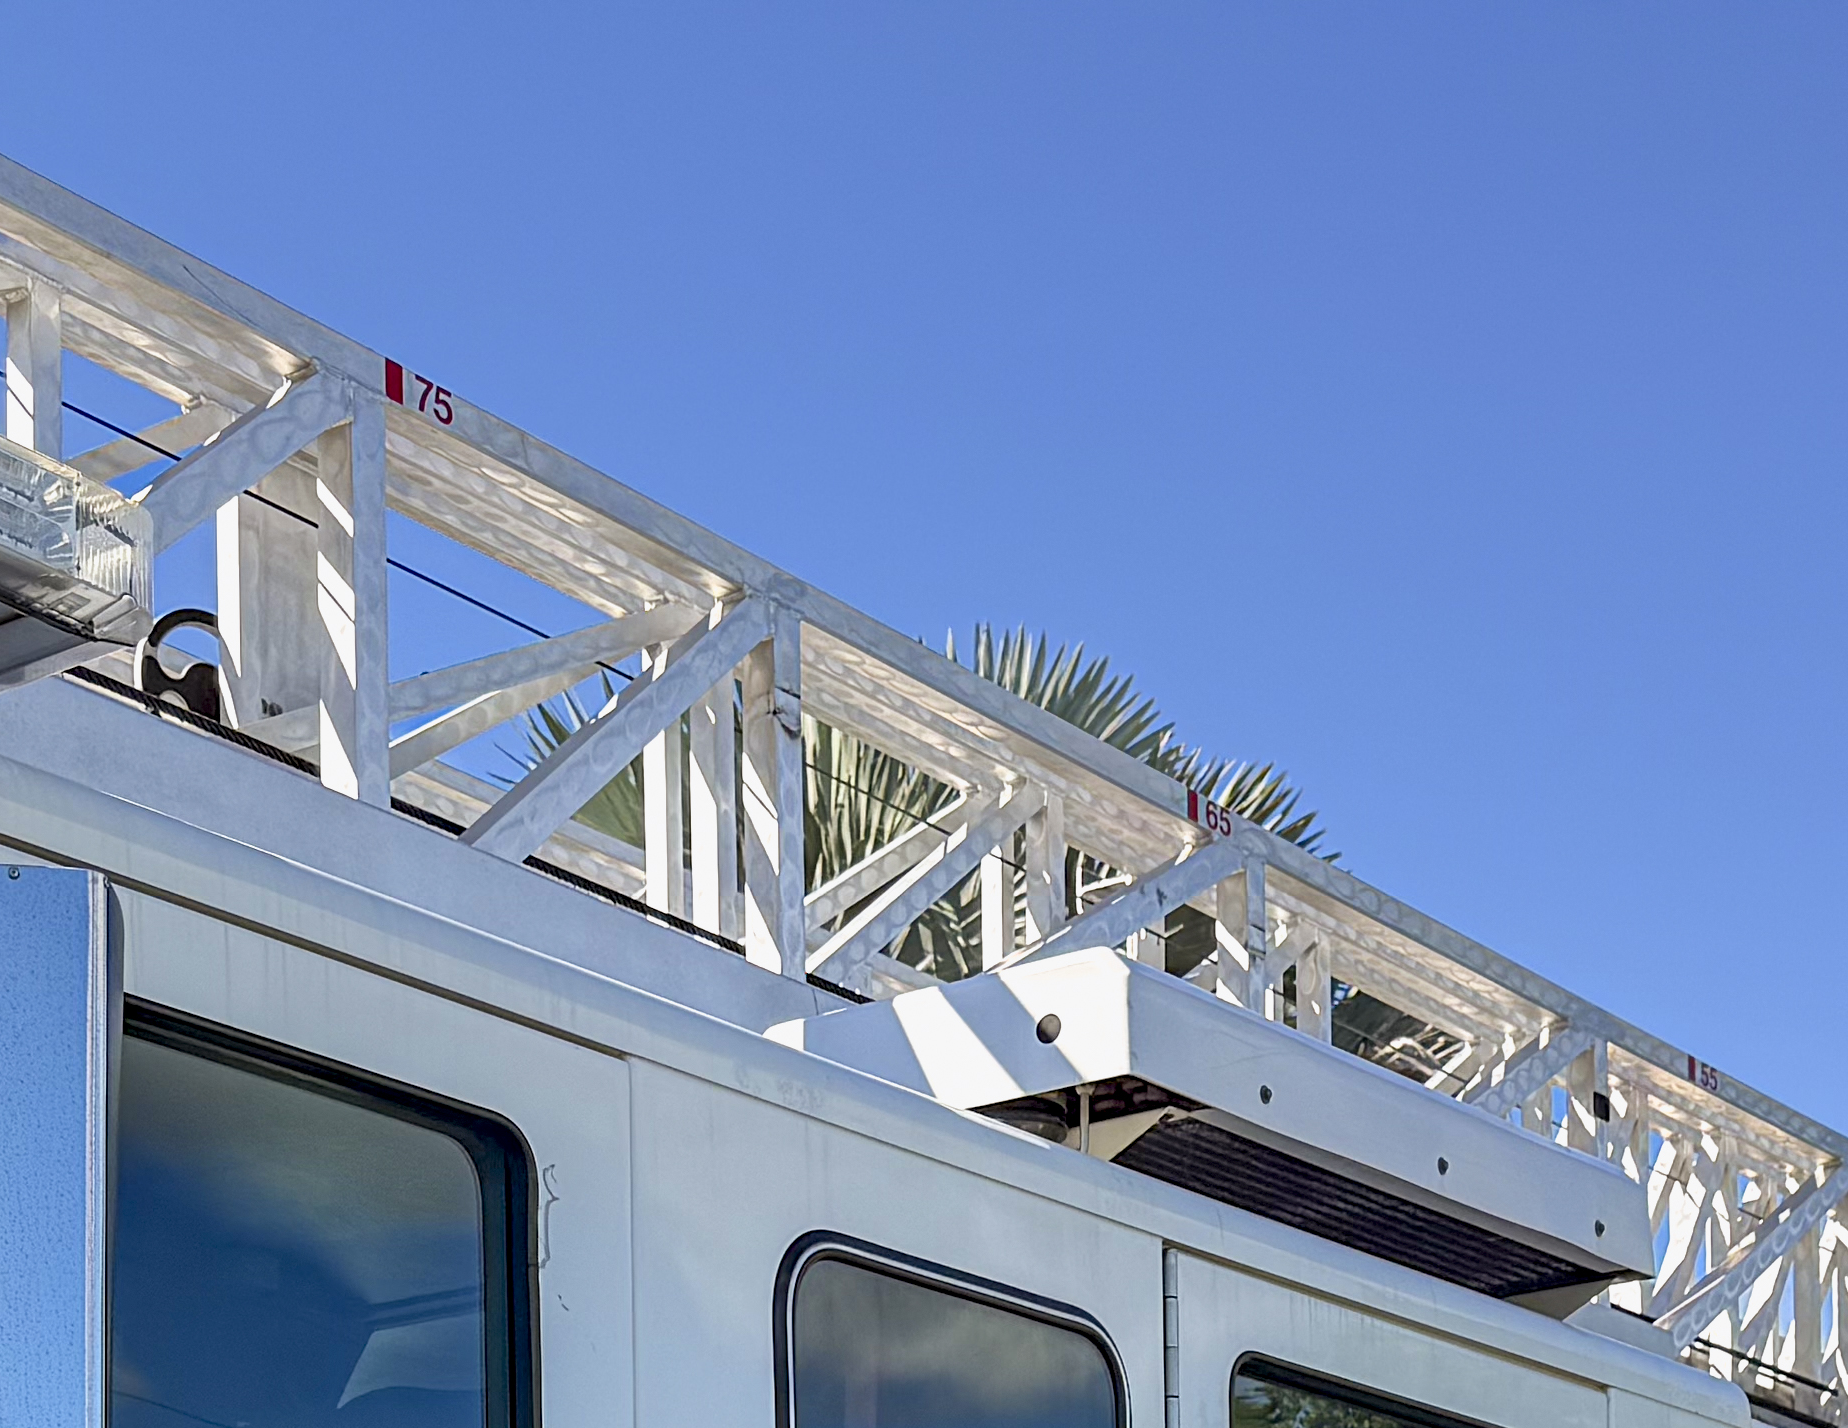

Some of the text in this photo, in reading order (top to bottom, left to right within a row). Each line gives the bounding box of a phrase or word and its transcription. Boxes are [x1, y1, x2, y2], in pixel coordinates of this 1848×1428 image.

[415, 374, 453, 425] 75
[1206, 800, 1231, 836] 65
[1701, 1062, 1718, 1091] 55
